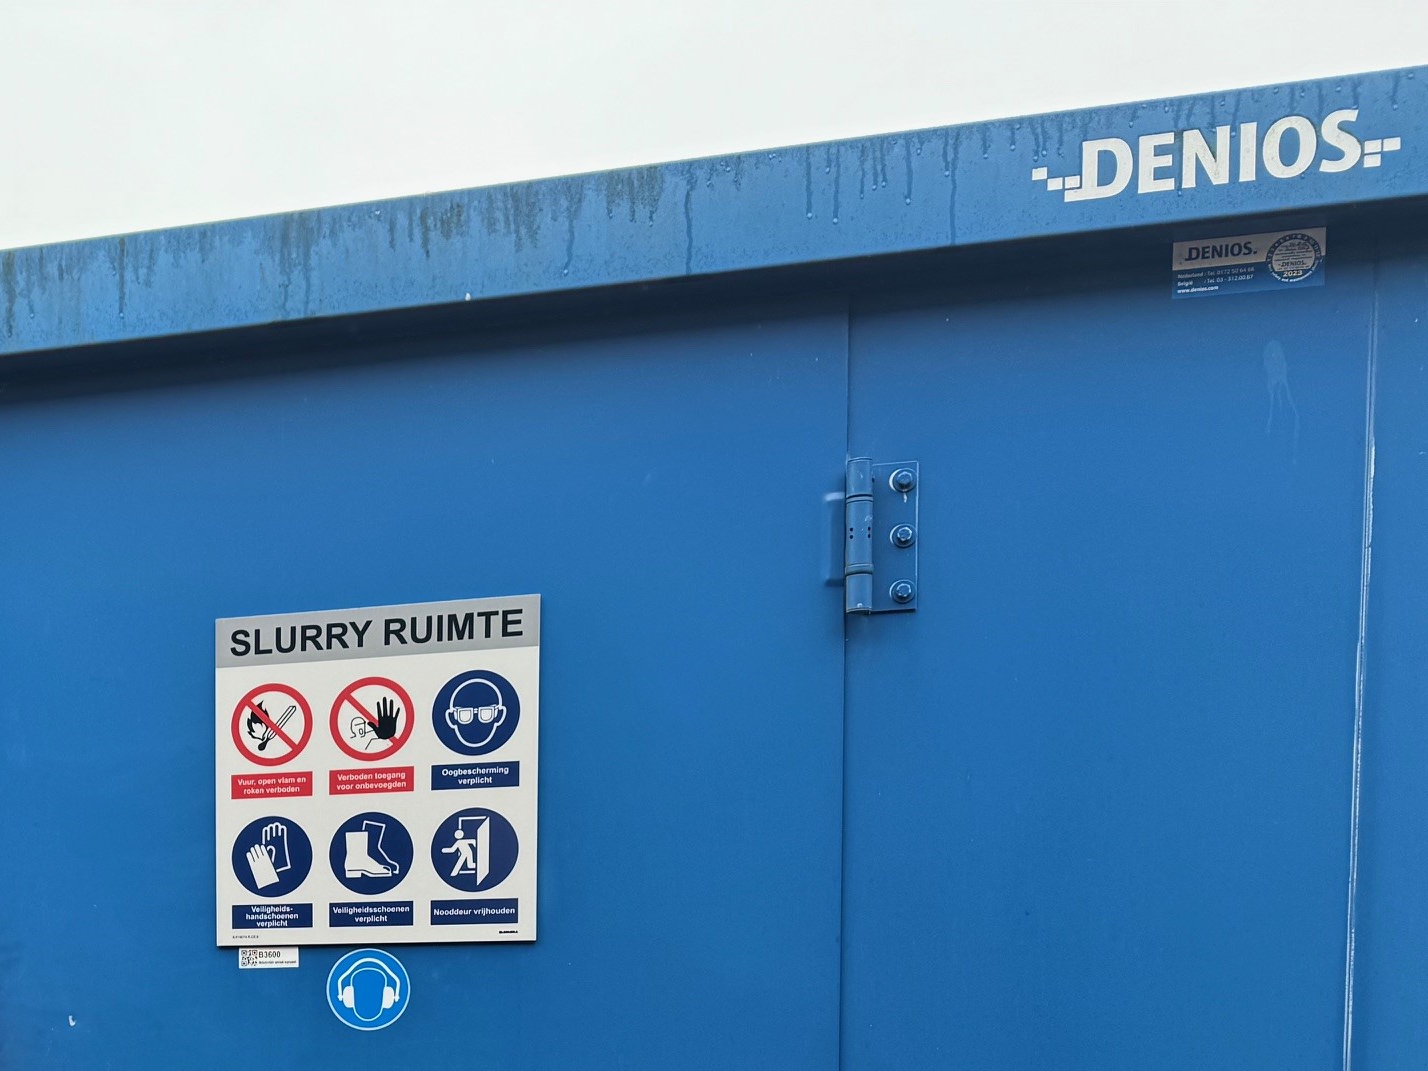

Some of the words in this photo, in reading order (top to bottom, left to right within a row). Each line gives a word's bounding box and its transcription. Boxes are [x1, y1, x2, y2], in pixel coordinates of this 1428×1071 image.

[1065, 109, 1362, 202] DENIOS
[1185, 241, 1253, 261] DENIOS
[1177, 285, 1218, 294] www.denios.com
[230, 620, 373, 656] SLURRY
[383, 608, 523, 645] RUIMTE
[441, 766, 509, 777] Oogbescherming
[337, 773, 372, 781] Verboden
[374, 772, 406, 781] toegang
[458, 776, 492, 785] verplicht
[237, 778, 256, 786] Vuur,
[258, 778, 276, 786] open
[355, 781, 407, 790] onbevoegden
[243, 787, 264, 795] roken
[266, 786, 300, 794] verboden
[251, 905, 293, 914] Veiligheids-
[332, 906, 410, 915] Veiligheidsschoenen
[433, 908, 472, 916] Nooddeur
[473, 907, 516, 916] vrijhouden
[245, 912, 299, 920] handschoenen
[354, 915, 388, 924] verplicht
[256, 919, 288, 928] verplicht
[258, 950, 281, 958] B3600
